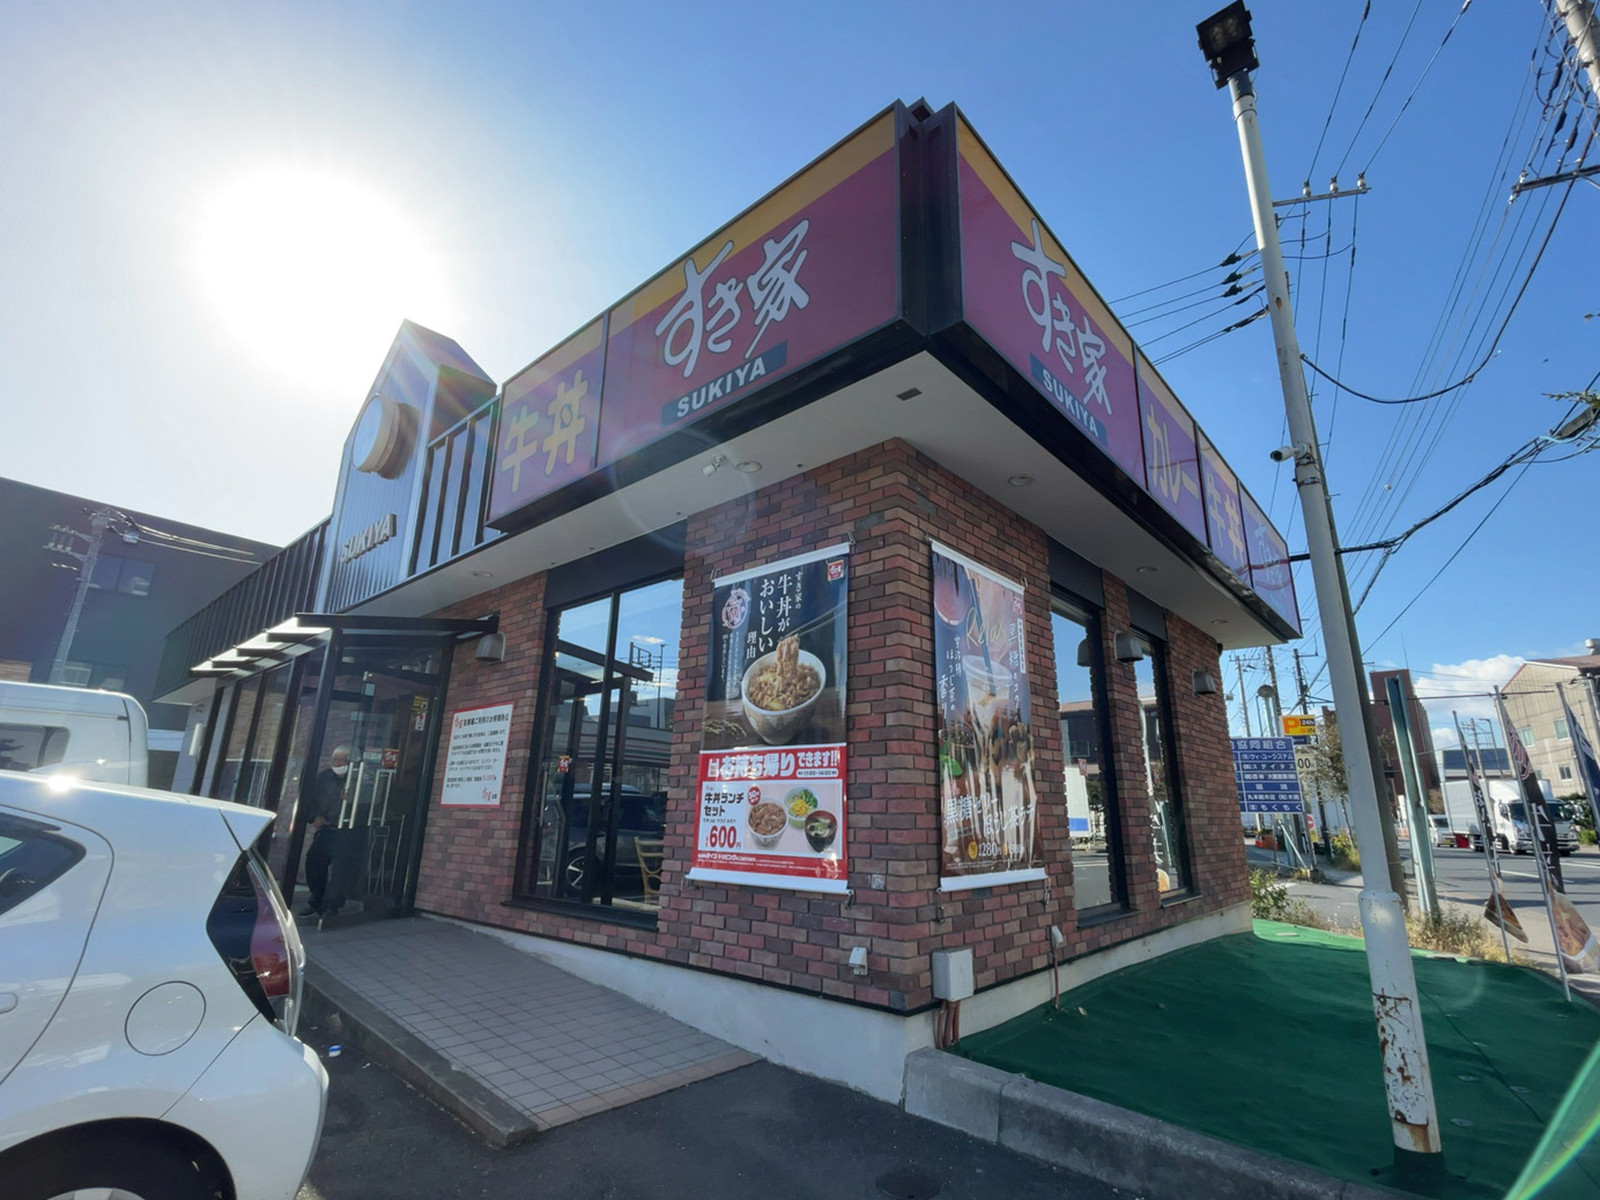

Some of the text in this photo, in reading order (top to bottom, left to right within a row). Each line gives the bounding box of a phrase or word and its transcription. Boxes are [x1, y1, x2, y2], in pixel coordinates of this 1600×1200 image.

[655, 219, 811, 378] すき家
[1011, 218, 1112, 416] すき家
[676, 356, 767, 418] SUKIYA
[1042, 369, 1099, 438] SUKIYA
[501, 368, 588, 493] 牛丼
[1146, 402, 1200, 504] カレー
[339, 513, 396, 563] SUKIYA
[1206, 472, 1244, 563] 牛丼
[758, 578, 775, 653] おいしい
[776, 573, 792, 632] 牛丼が
[794, 571, 804, 609] すき家の
[746, 630, 757, 659] 理由
[966, 607, 1007, 650] Relax
[1283, 717, 1301, 734] P
[720, 752, 796, 778] お持ち帰り
[704, 792, 744, 804] 牛丼ランチ
[704, 805, 726, 817] セット
